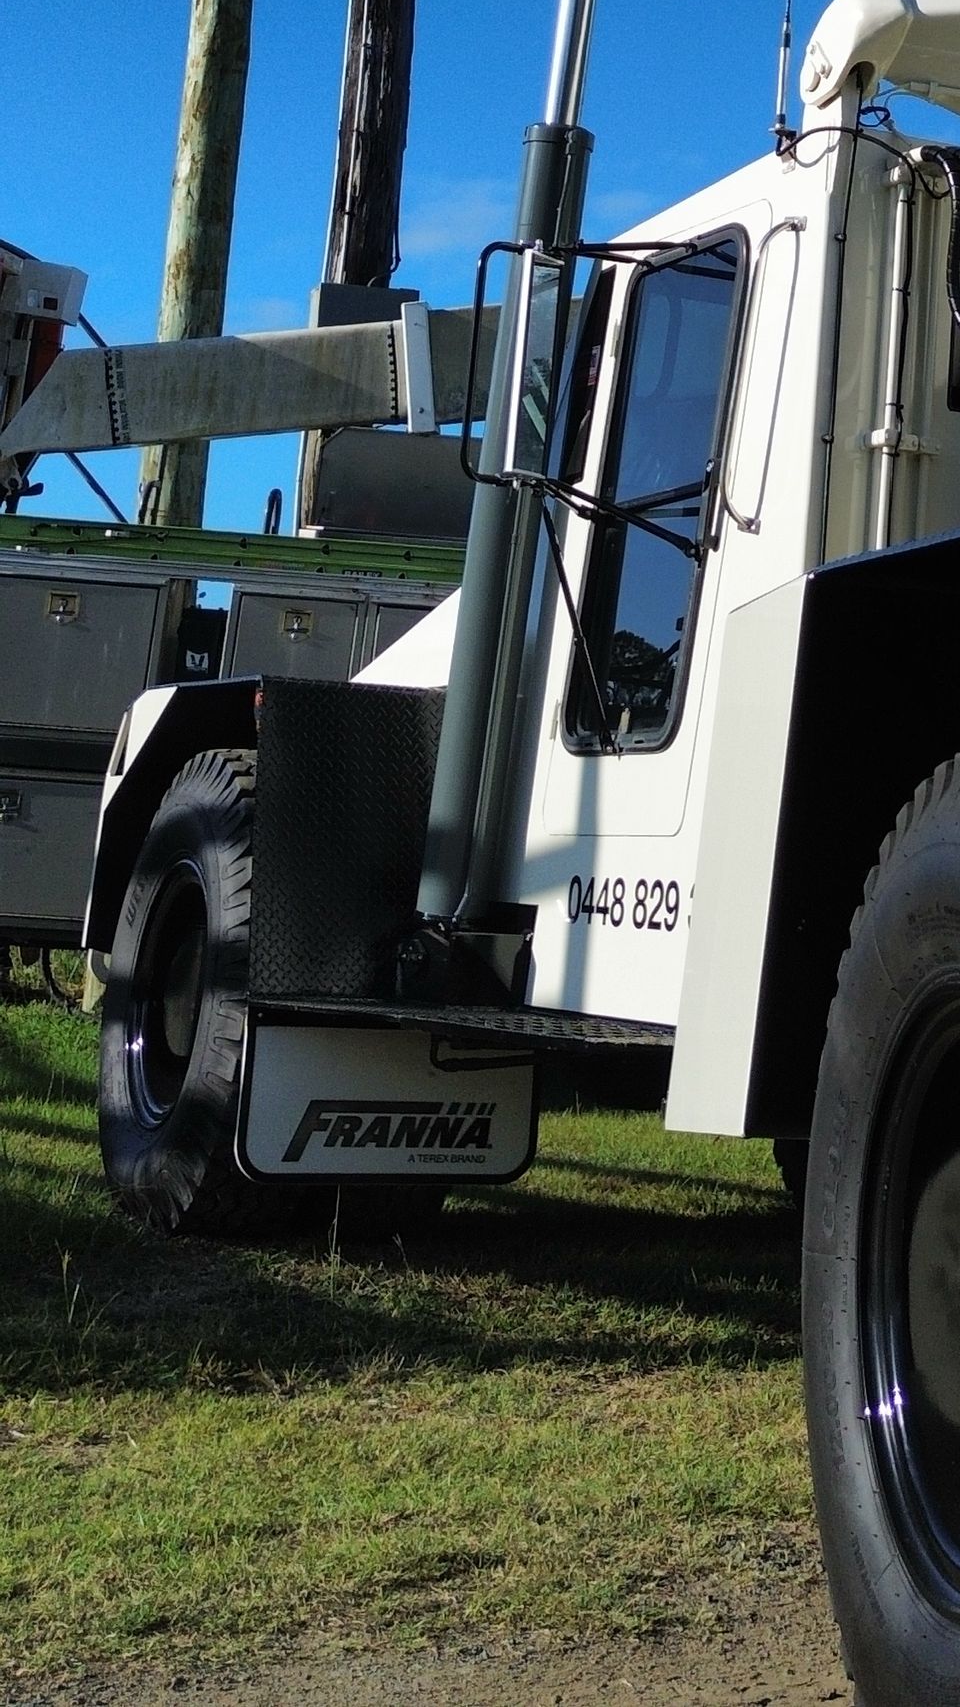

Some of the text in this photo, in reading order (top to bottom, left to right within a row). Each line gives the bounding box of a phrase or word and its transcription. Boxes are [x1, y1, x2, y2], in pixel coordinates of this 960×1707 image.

[568, 875, 626, 928] 0448
[632, 878, 680, 932] 829
[281, 1099, 496, 1162] FRANNA
[407, 1154, 486, 1164] A TEREX BRAND
